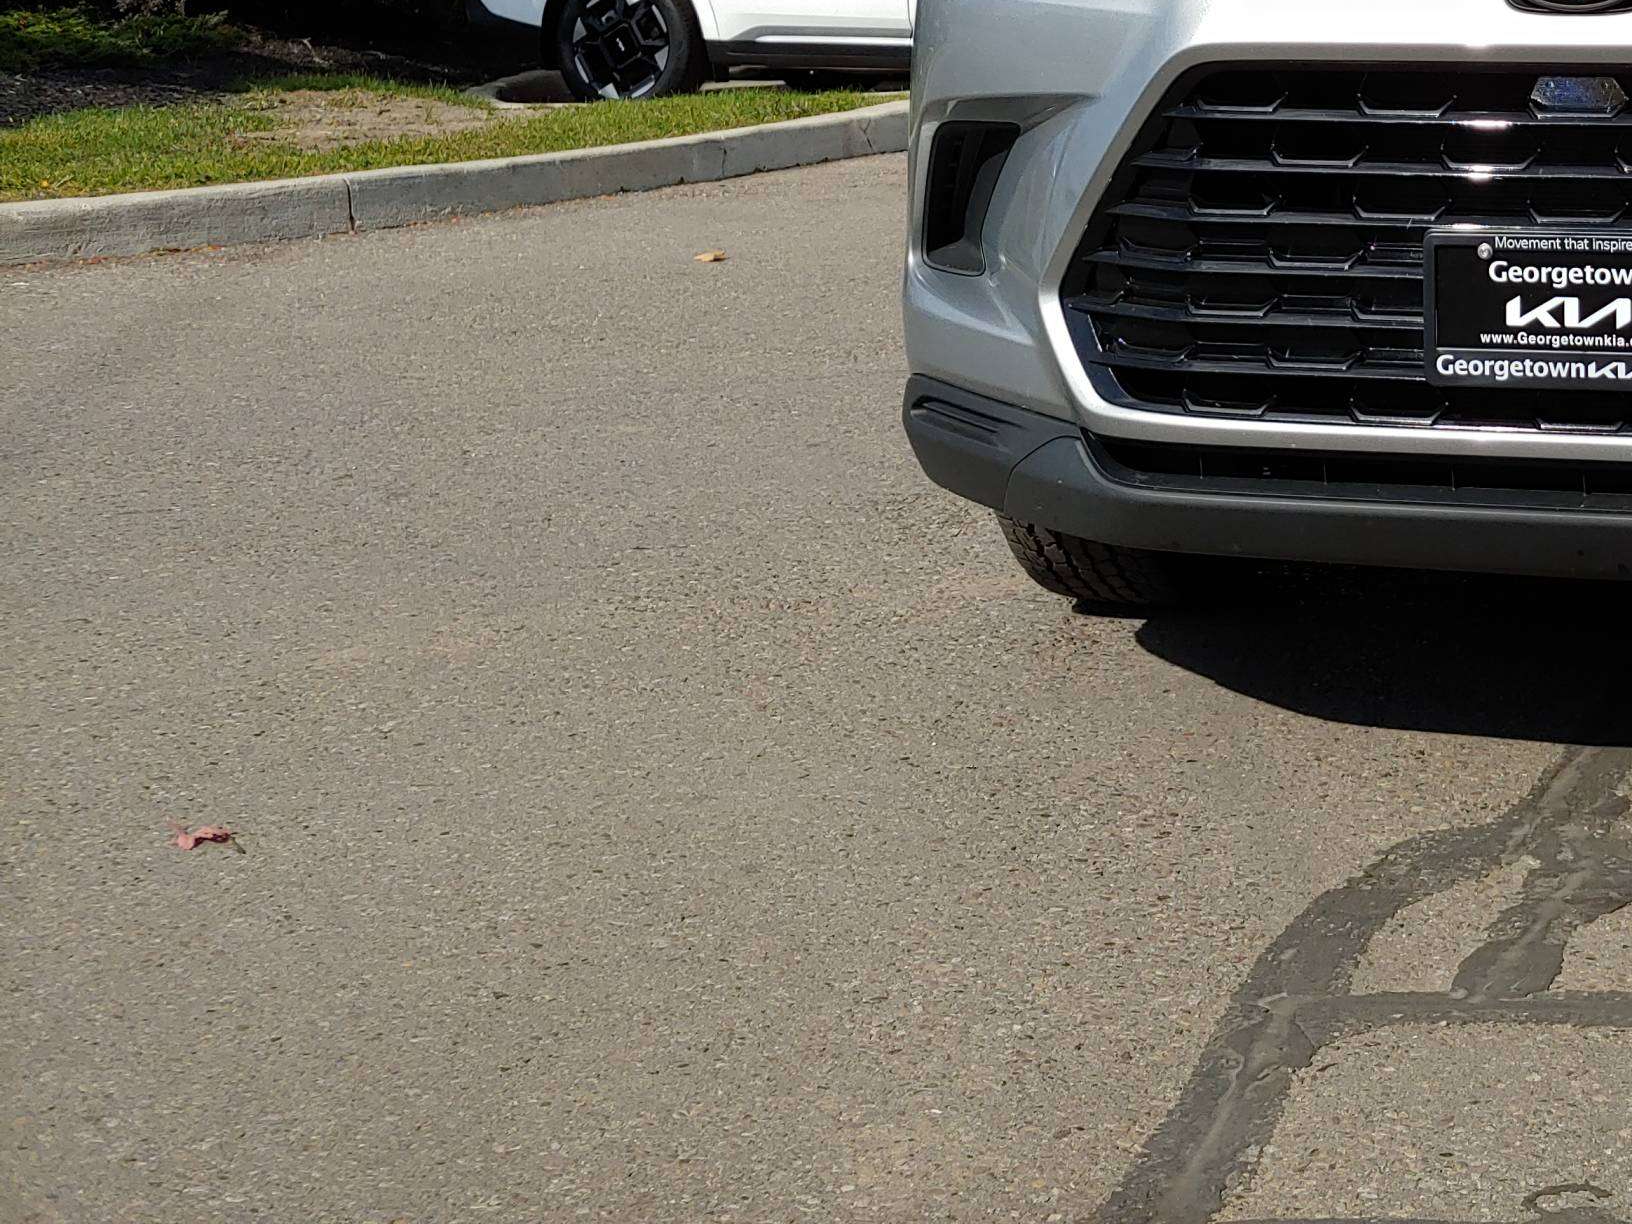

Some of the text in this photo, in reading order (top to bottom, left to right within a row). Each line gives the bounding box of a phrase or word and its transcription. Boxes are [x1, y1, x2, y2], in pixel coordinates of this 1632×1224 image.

[1494, 235, 1561, 250] Movement
[1564, 237, 1590, 251] that
[1505, 295, 1632, 330] KIA
